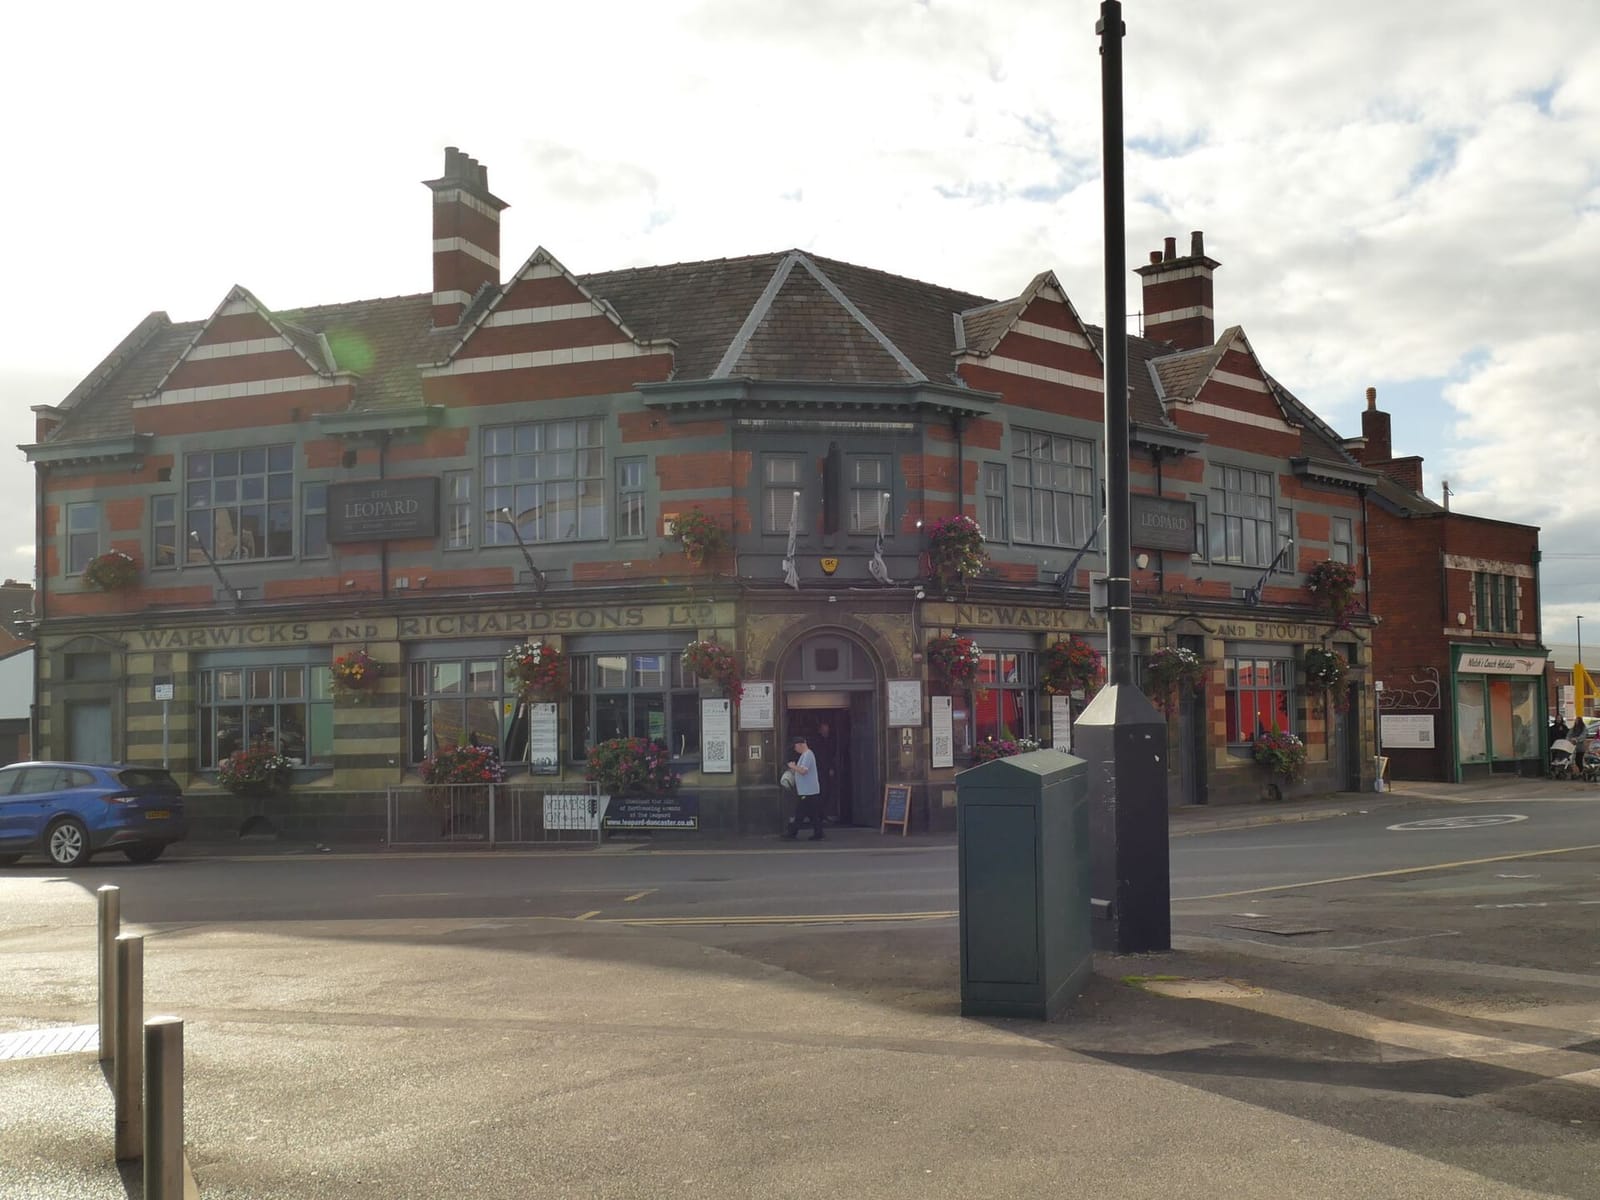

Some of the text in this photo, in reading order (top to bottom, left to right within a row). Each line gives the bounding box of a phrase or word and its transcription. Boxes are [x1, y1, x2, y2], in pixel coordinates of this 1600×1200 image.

[344, 499, 419, 519] LEOPARD
[1141, 512, 1188, 531] LEOPARD
[399, 607, 645, 636] RICHARDSONS
[956, 606, 1067, 628] NEWARK
[1217, 623, 1246, 637] AND
[1254, 622, 1317, 640] STOUTS
[141, 623, 379, 648] WARWICKS AND
